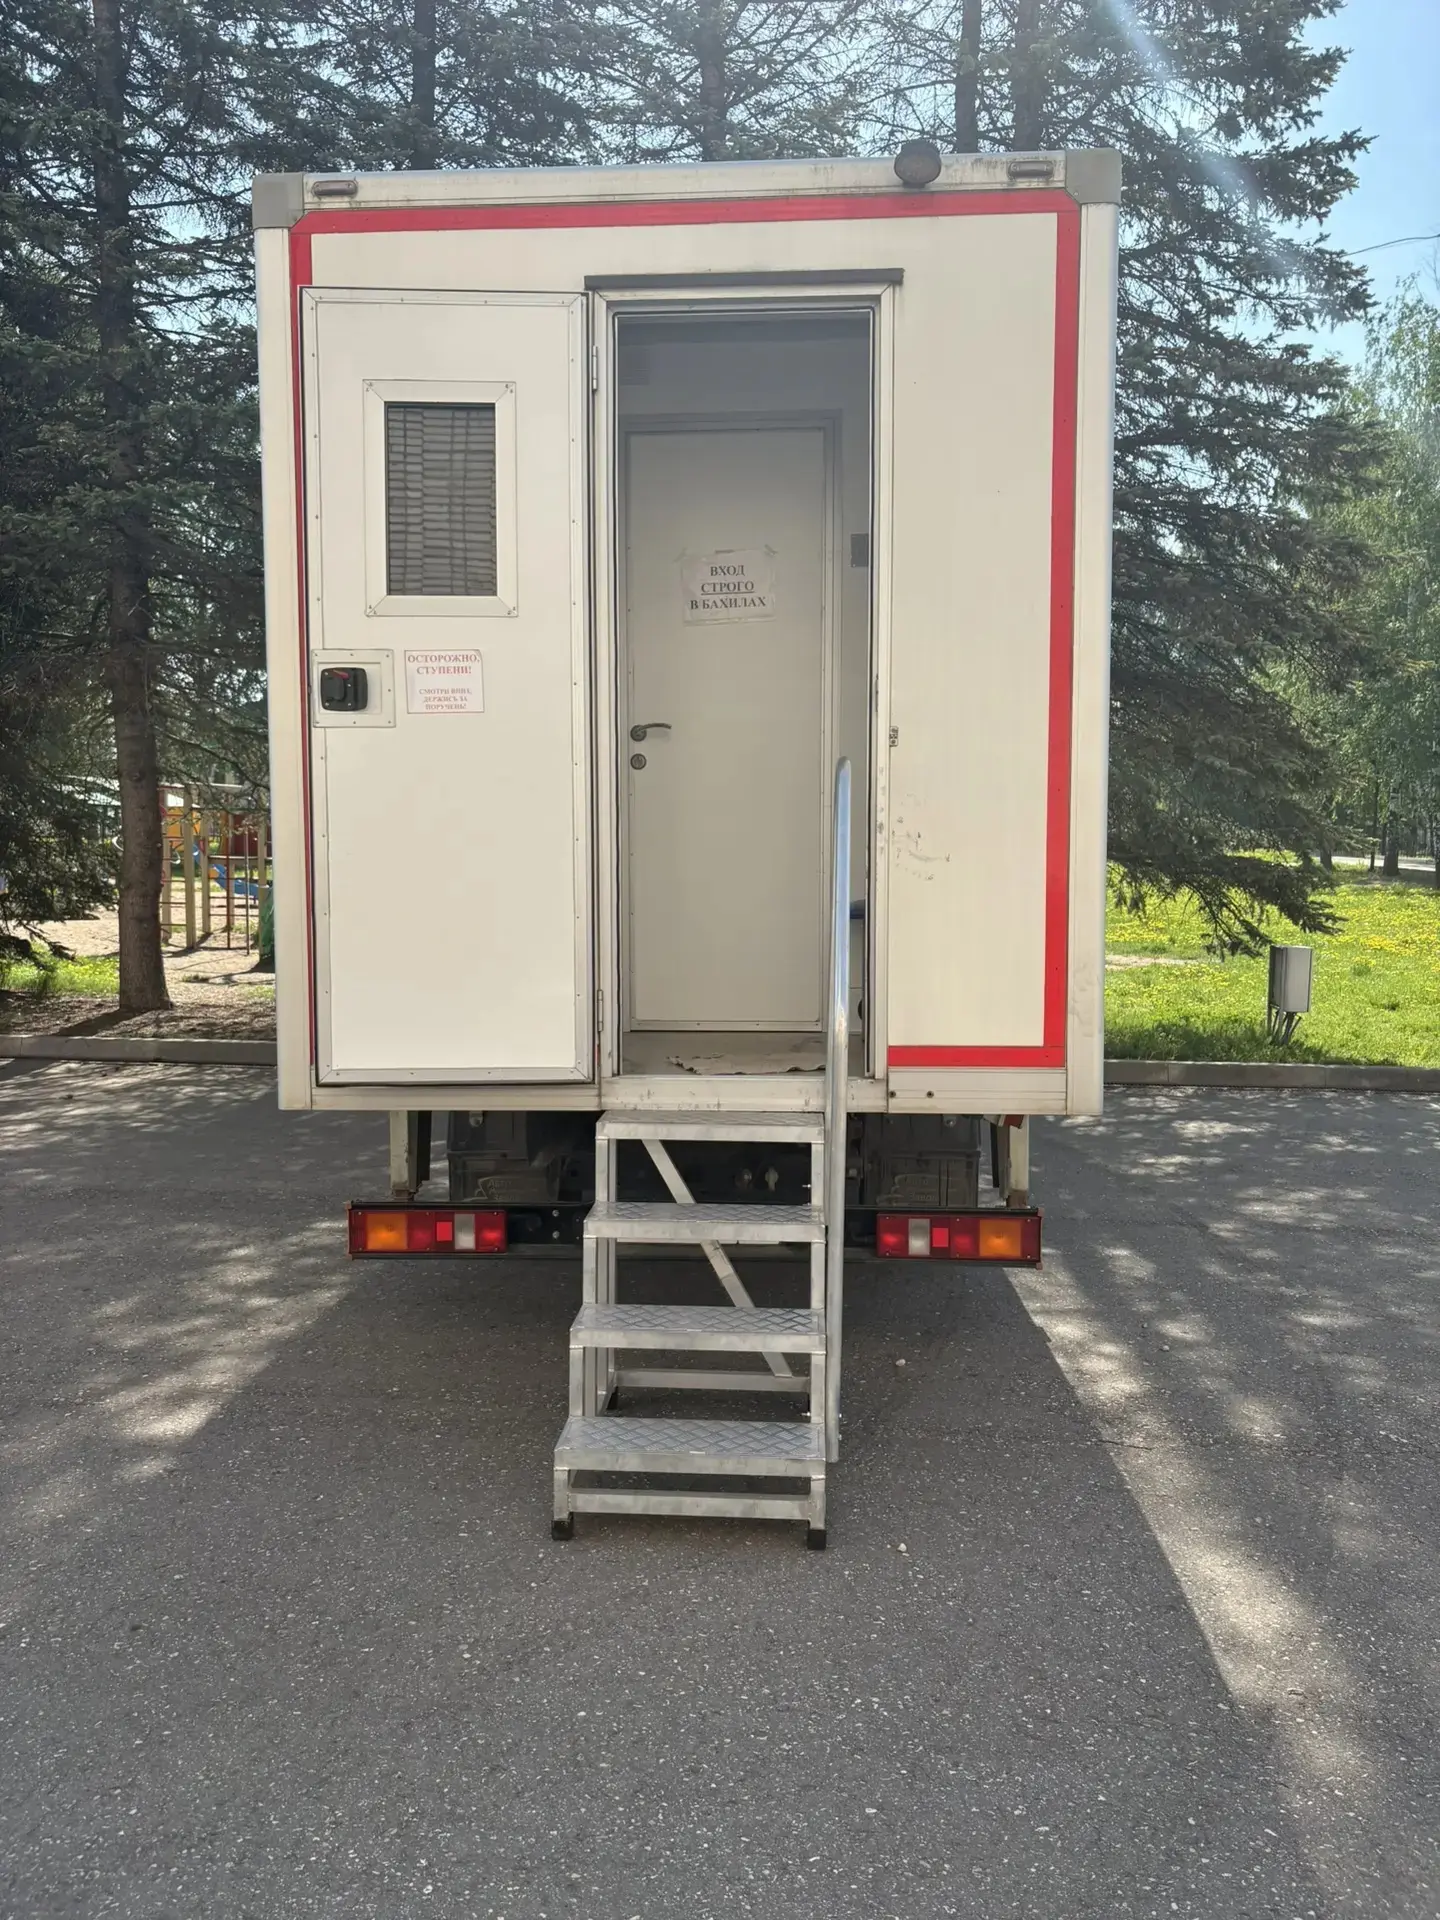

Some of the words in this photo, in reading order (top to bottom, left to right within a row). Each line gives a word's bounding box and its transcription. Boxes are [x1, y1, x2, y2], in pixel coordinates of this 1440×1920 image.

[710, 565, 745, 576] ВХОД
[701, 581, 755, 594] СТРОГО
[690, 600, 699, 610] В
[702, 596, 767, 610] БАХИЛАХ
[416, 666, 472, 674] СТУПЕНИ!
